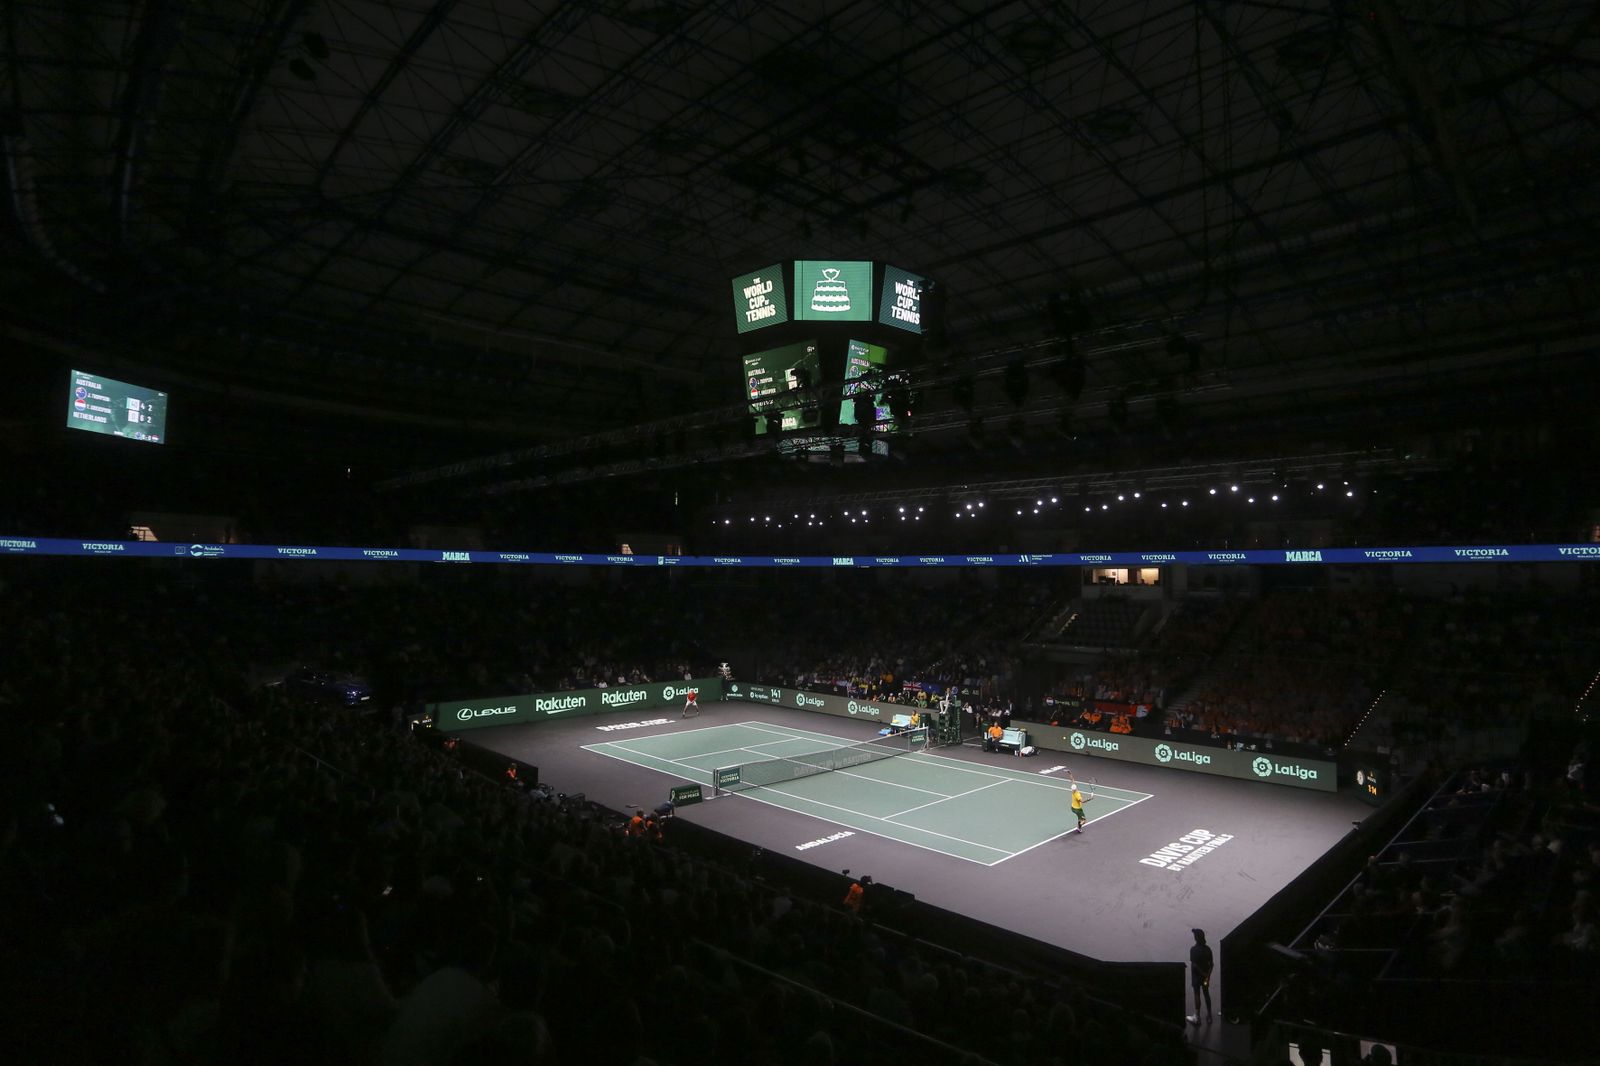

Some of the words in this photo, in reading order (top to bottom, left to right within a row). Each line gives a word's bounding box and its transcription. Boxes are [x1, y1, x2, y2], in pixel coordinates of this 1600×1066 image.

[743, 280, 773, 300] WORLD
[895, 281, 922, 301] WORL
[749, 295, 765, 310] CUP
[896, 295, 914, 311] CUP
[745, 304, 776, 323] TENNIS
[891, 305, 920, 325] TENNIS
[148, 404, 153, 412] 2
[0, 540, 37, 548] VICTORIA
[82, 543, 125, 551] VICTORIA
[442, 551, 470, 561] MARCA
[1285, 551, 1322, 562] MARCA
[1364, 550, 1413, 558] VICTORIA
[1558, 547, 1600, 555] VICTO
[832, 557, 854, 566] MARCA
[601, 690, 647, 705] Rakuten
[770, 689, 780, 699] 141
[535, 696, 586, 712] Rakuten
[805, 698, 825, 708] LaLiga
[474, 706, 516, 717] LEXUS
[858, 705, 880, 716] LaLiga
[1087, 738, 1119, 752] LaLiga
[1174, 749, 1211, 765] LaLiga
[1275, 763, 1318, 780] LaLiga
[1139, 842, 1195, 868] DAVIS
[1179, 829, 1216, 845] CUP
